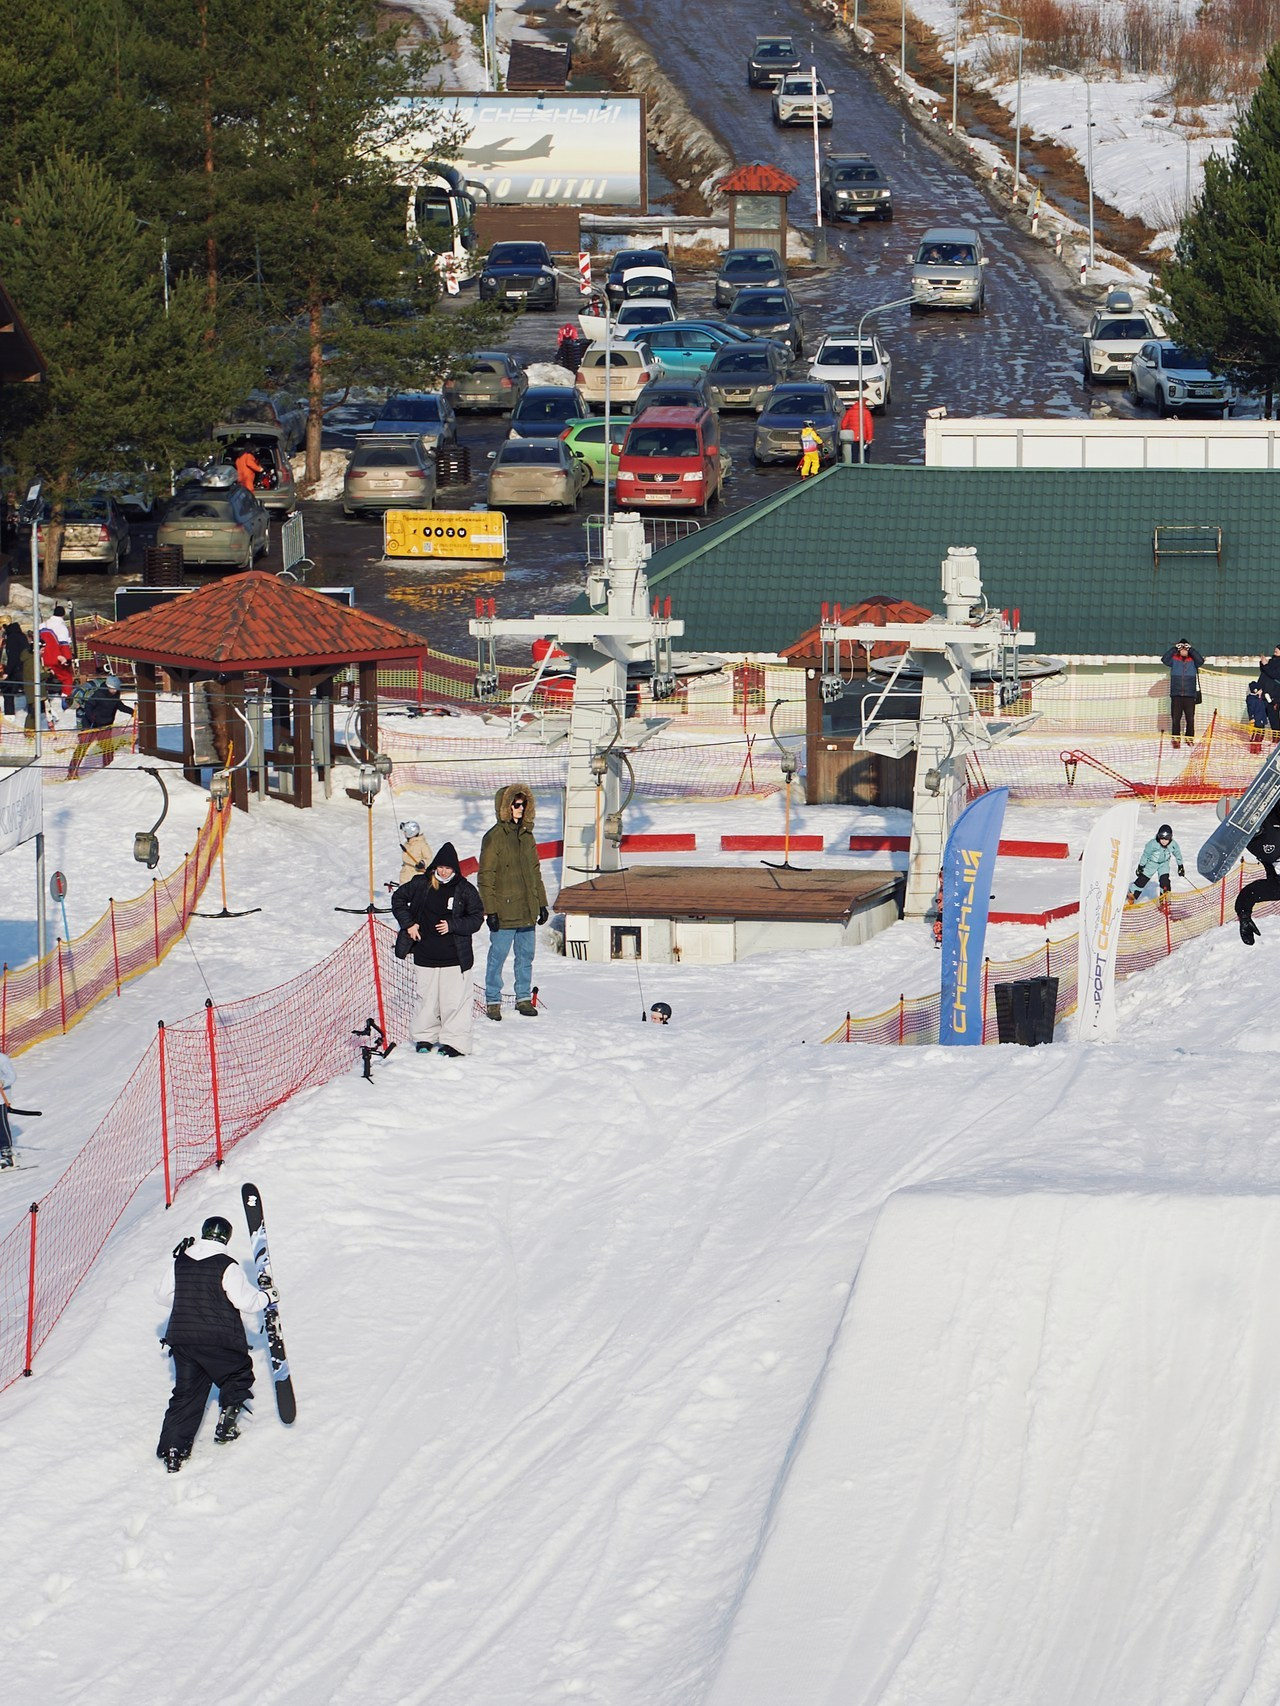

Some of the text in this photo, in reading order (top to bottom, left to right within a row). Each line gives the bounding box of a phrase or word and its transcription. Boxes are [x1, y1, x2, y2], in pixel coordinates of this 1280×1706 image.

[479, 106, 621, 124] СНЕЖНЫЙ!
[527, 178, 608, 199] ПУТИ!
[953, 850, 983, 1034] СНЕЖНЫЙ
[1093, 953, 1107, 1028] РОРТ
